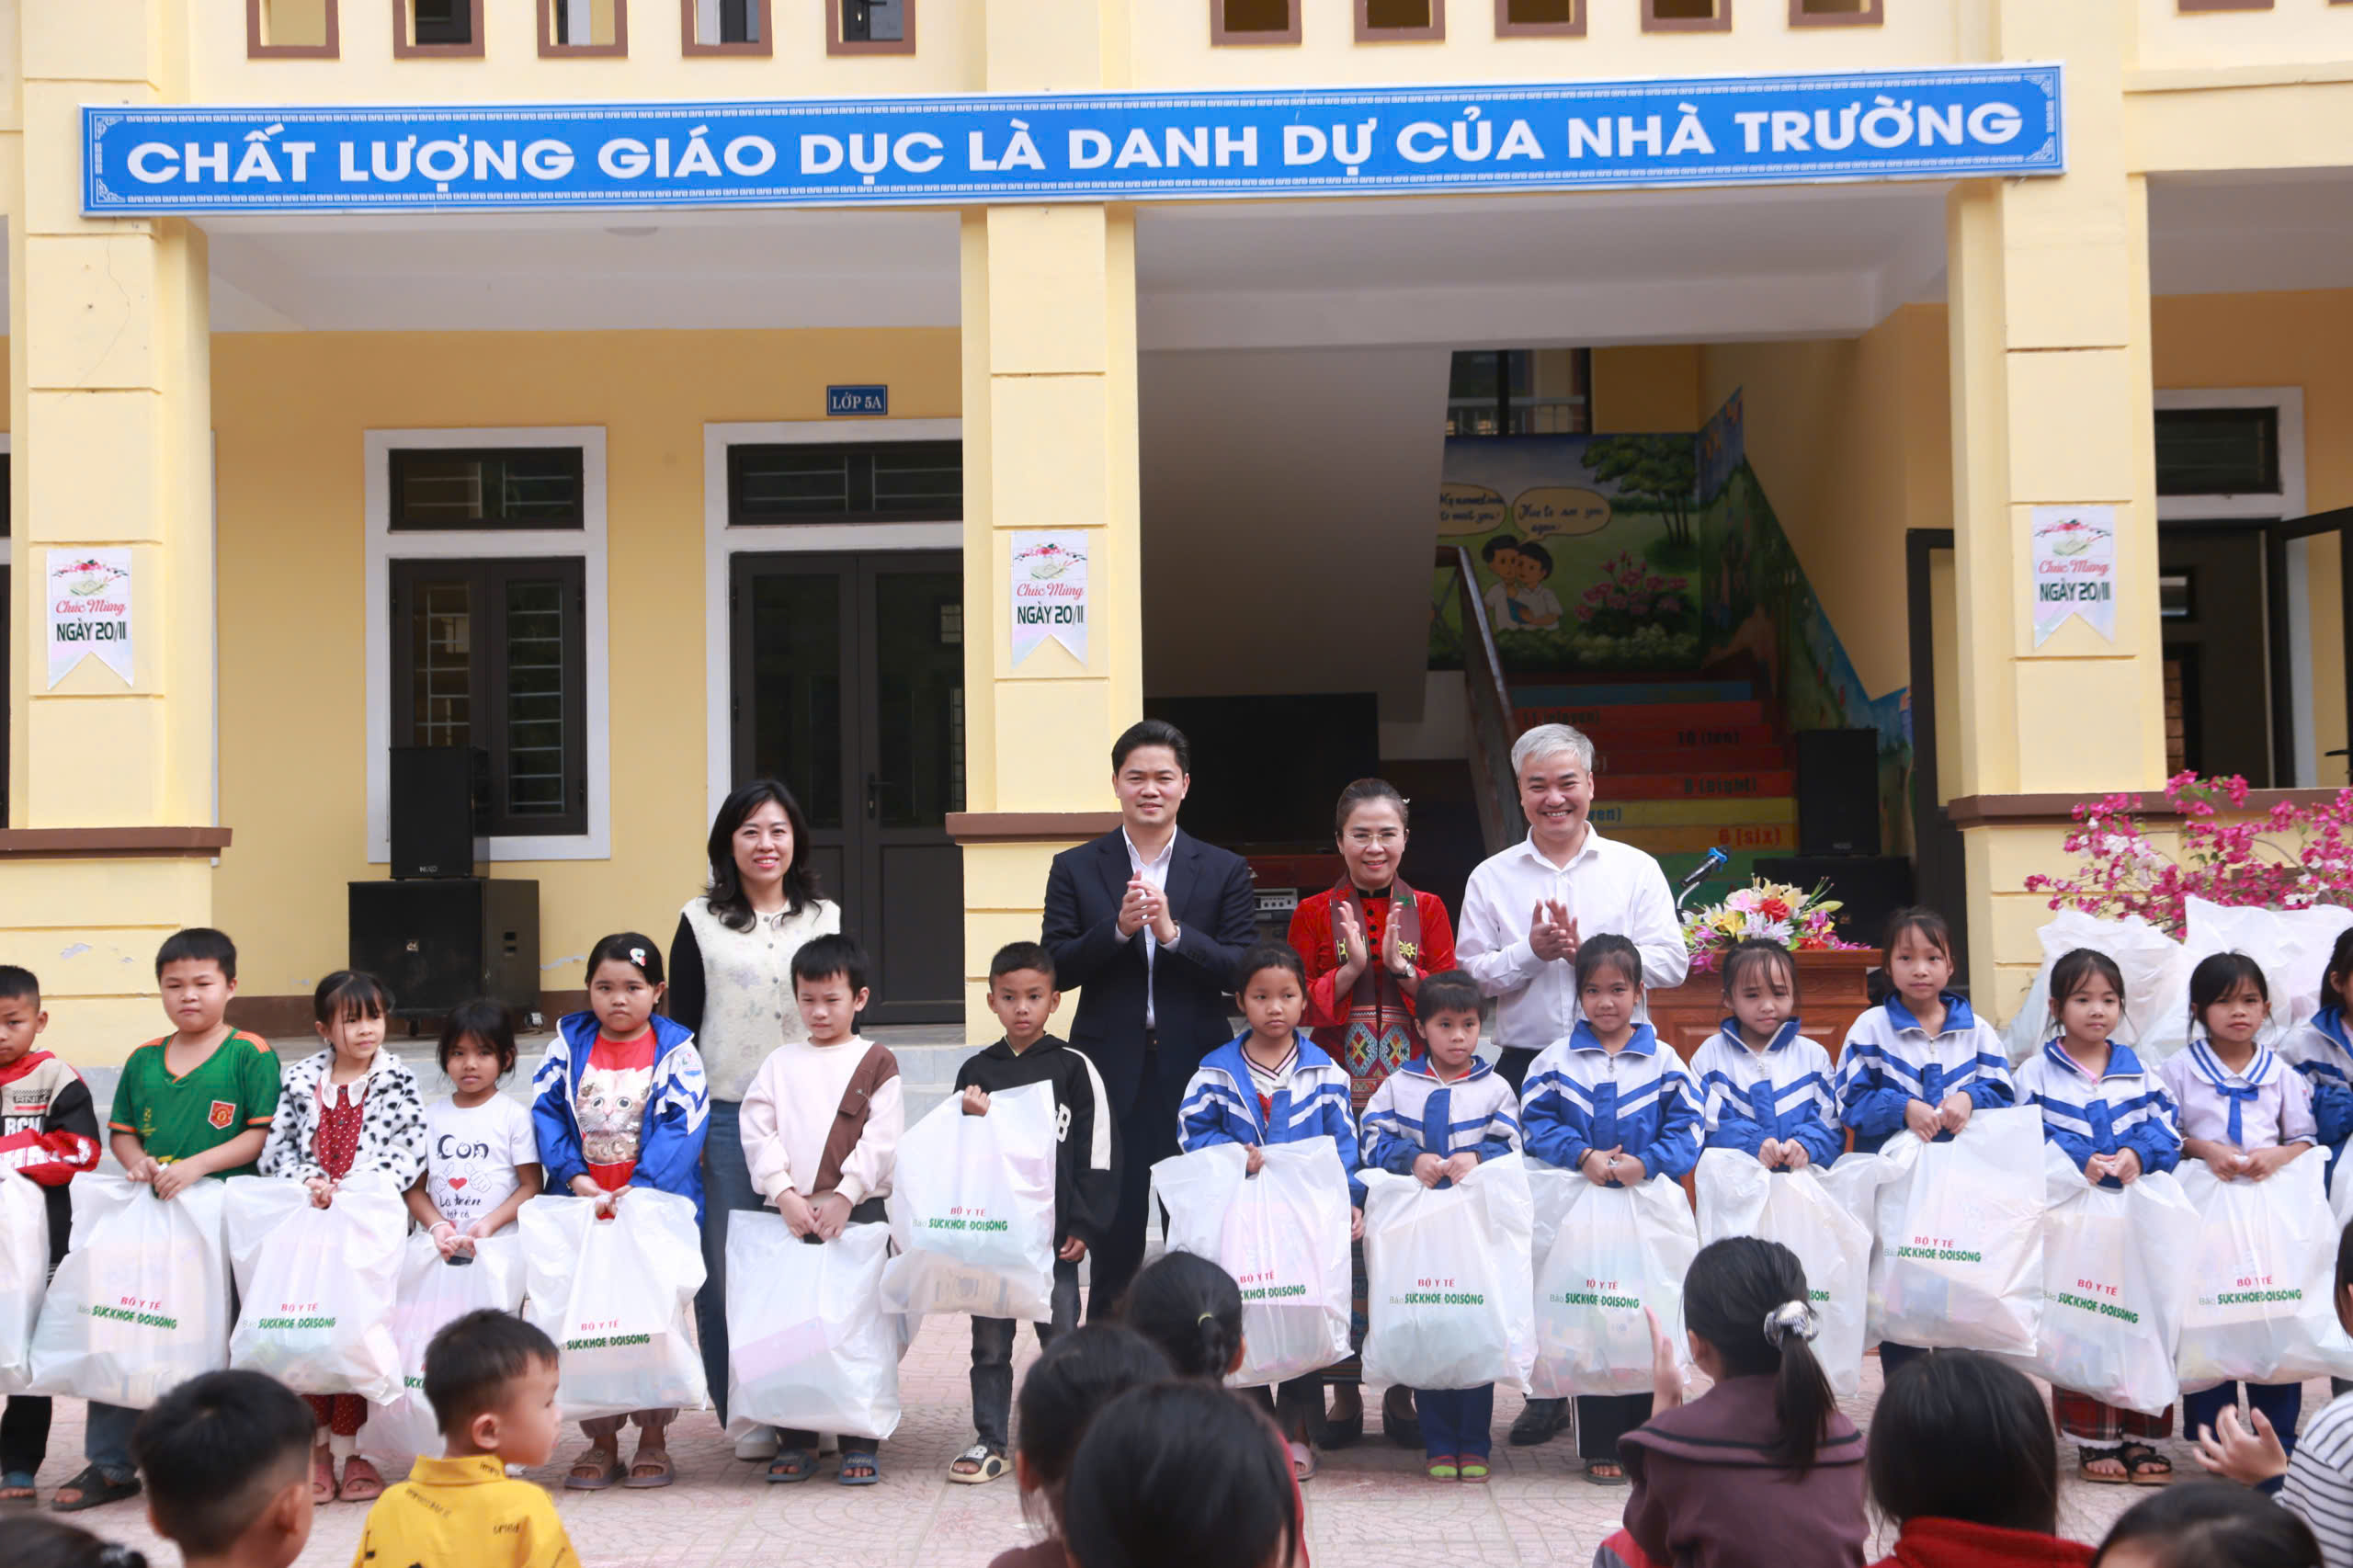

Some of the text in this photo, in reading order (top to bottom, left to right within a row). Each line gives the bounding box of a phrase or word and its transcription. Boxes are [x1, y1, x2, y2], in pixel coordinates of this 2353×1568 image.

[128, 96, 2022, 192] CHẤT LƯỢNG GIÁO DỤC LÀ DANH DỰ CỦA NHÀ TRƯỜNG
[832, 392, 881, 409] LỚP 5A
[2040, 578, 2077, 602] NGÀY
[1017, 601, 1052, 624] NGÀY
[56, 618, 93, 641] NGÀY
[437, 1134, 489, 1160] Con
[1435, 1278, 1440, 1287] Y
